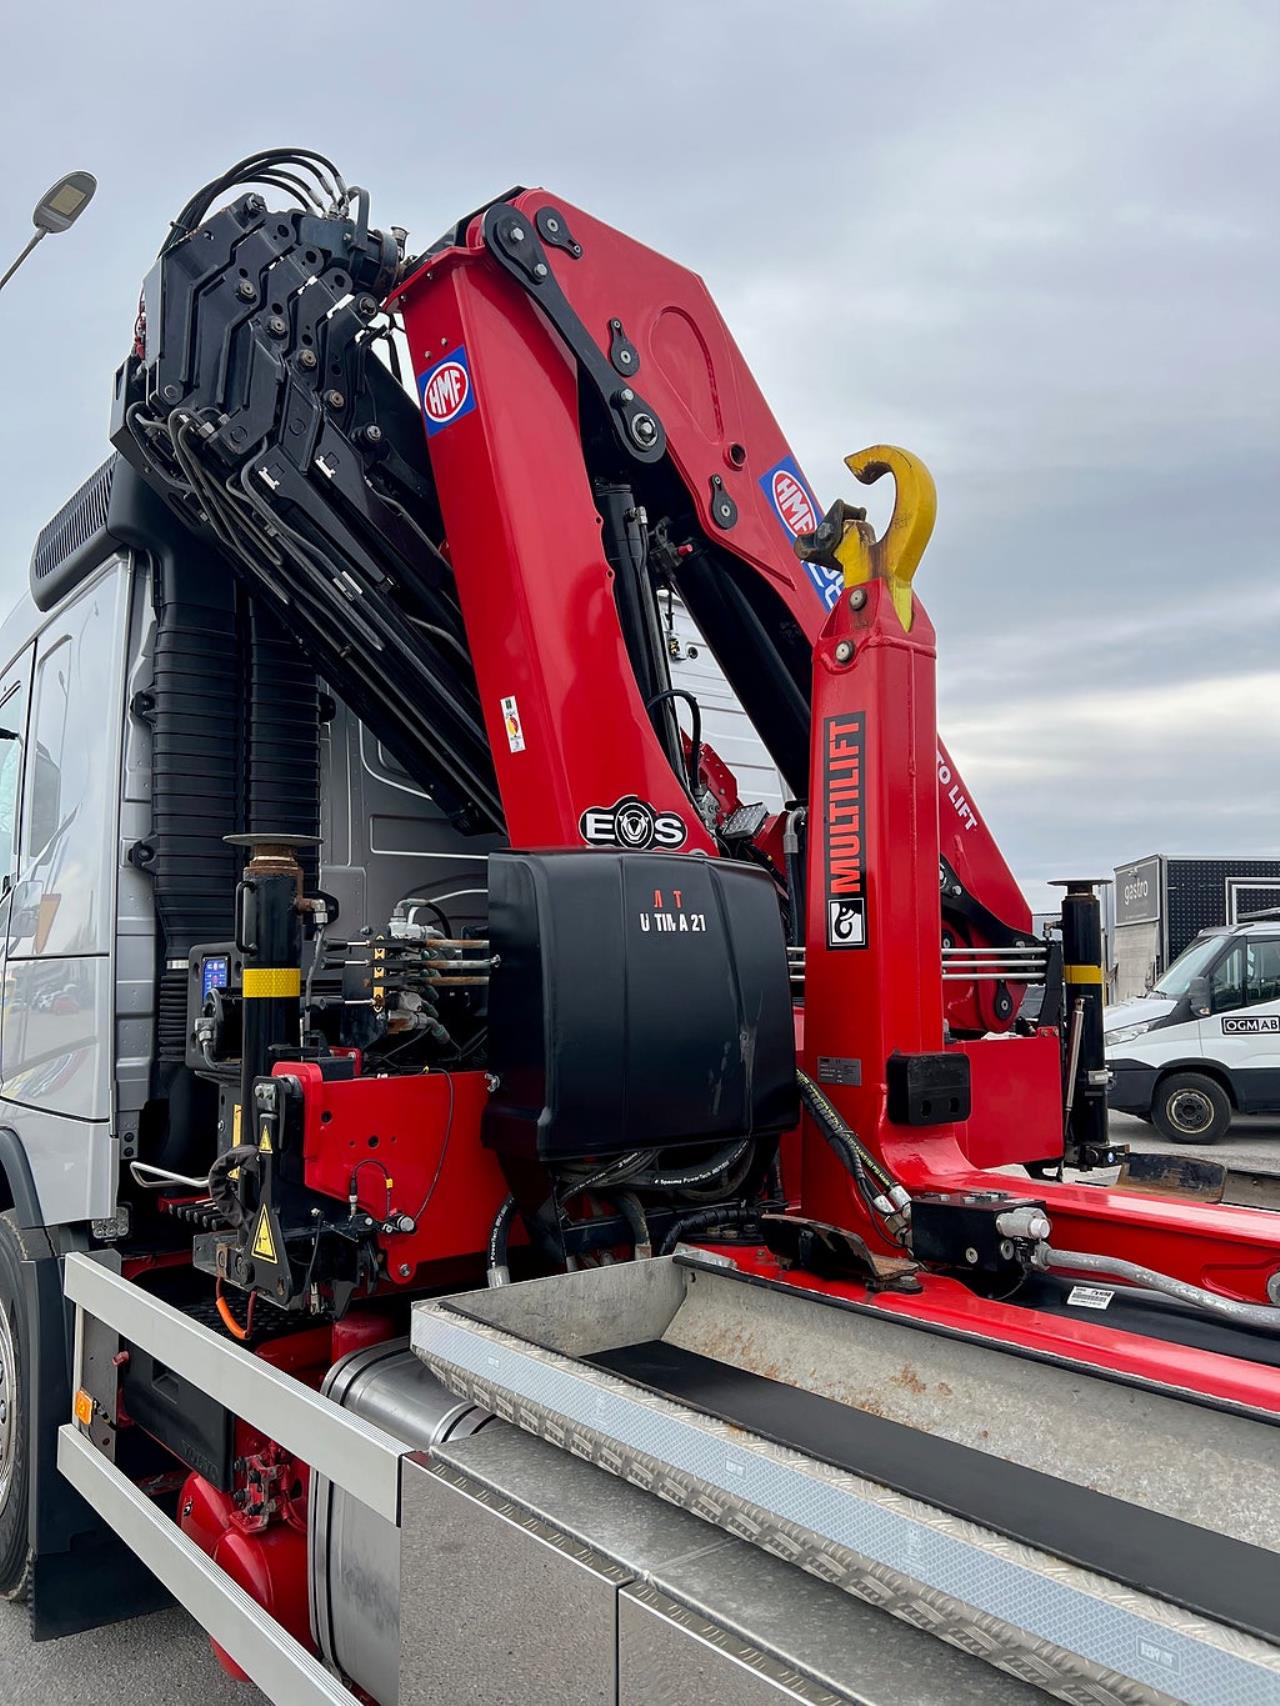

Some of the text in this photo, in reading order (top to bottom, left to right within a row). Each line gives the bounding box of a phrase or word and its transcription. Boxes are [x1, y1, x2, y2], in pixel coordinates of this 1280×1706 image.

[429, 369, 461, 415] HMF
[777, 477, 813, 535] HMF
[830, 721, 860, 894] MULTILIFT
[948, 785, 978, 830] LIFT
[690, 914, 706, 932] 21
